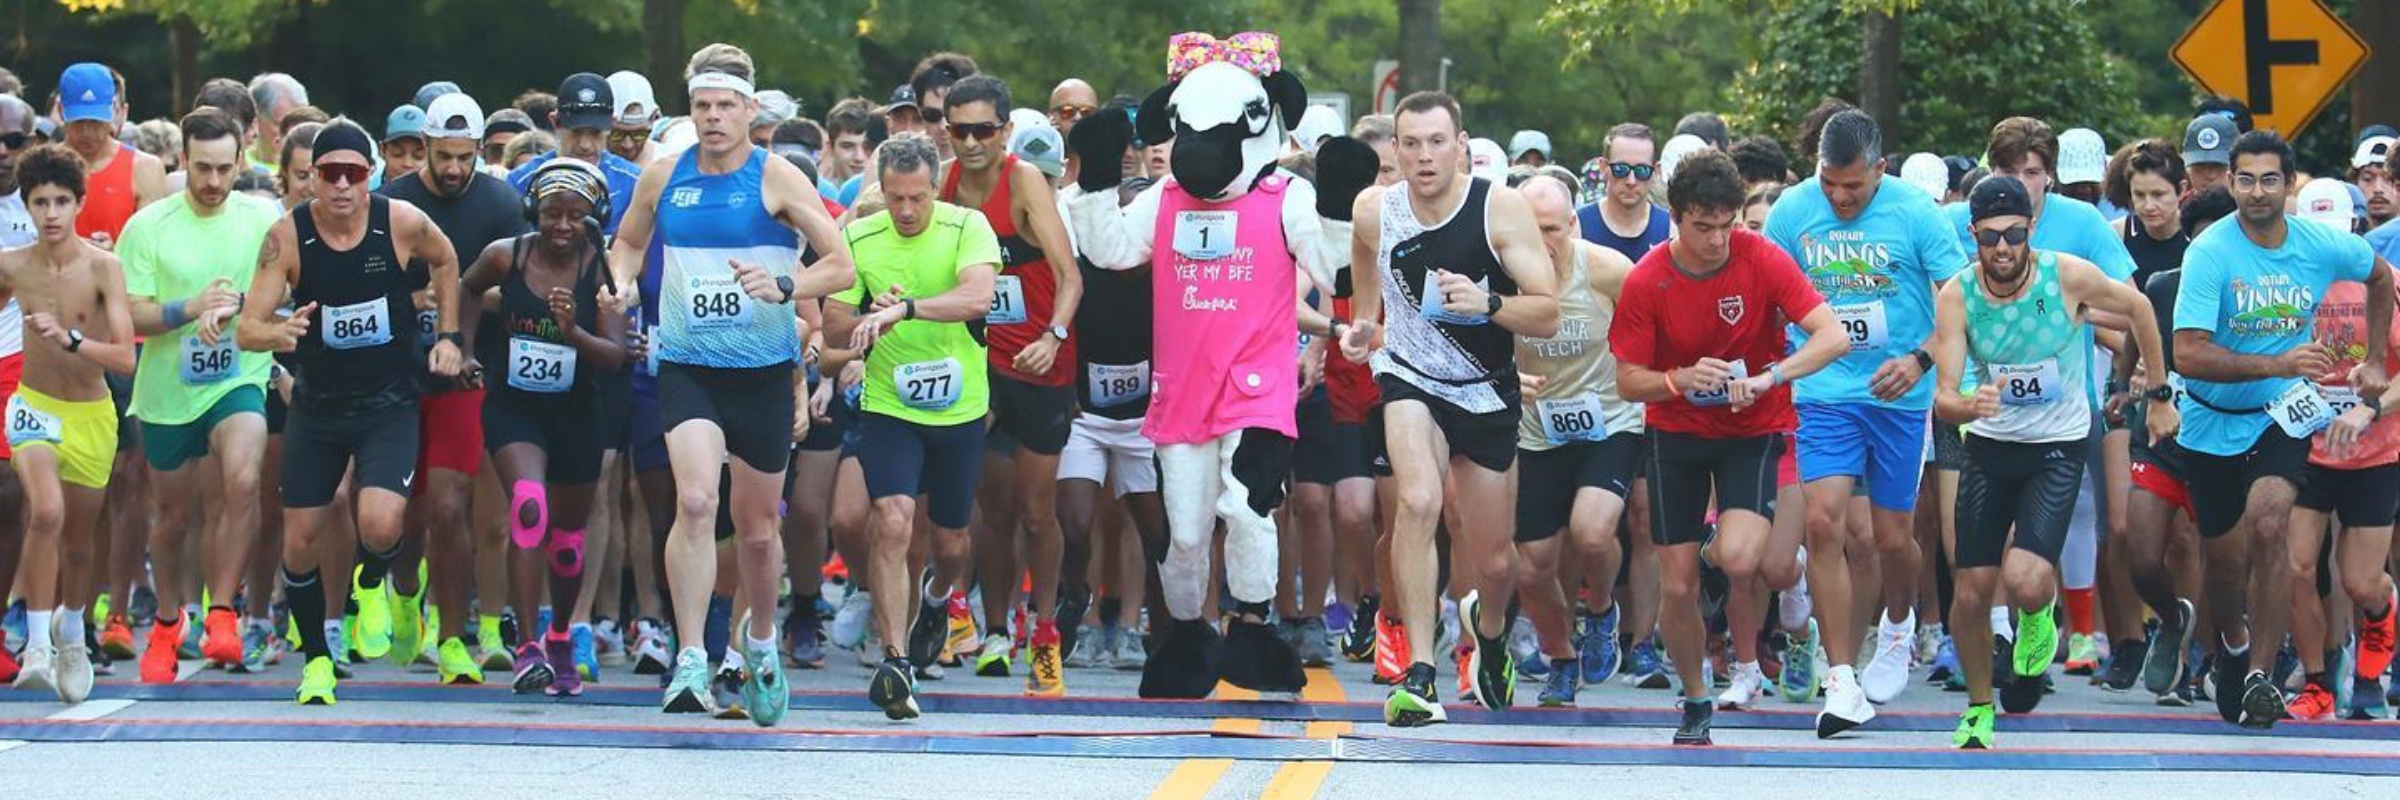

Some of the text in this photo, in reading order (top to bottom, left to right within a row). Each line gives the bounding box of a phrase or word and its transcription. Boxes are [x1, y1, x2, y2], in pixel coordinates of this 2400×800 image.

[1199, 226, 1209, 249] 1
[1804, 242, 1889, 268] VININGS
[1174, 263, 1199, 281] YER
[1203, 265, 1221, 280] MY
[1853, 273, 1877, 288] 5K
[693, 292, 741, 318] 848
[2236, 285, 2313, 313] VININGS
[333, 314, 379, 339] 864
[1533, 341, 1583, 357] TECH
[191, 348, 233, 374] 546
[518, 355, 563, 381] 234
[907, 374, 951, 401] 277
[1099, 376, 1140, 398] 189
[2011, 377, 2042, 398] 84
[14, 408, 47, 431] 88
[1551, 410, 1595, 433] 860
